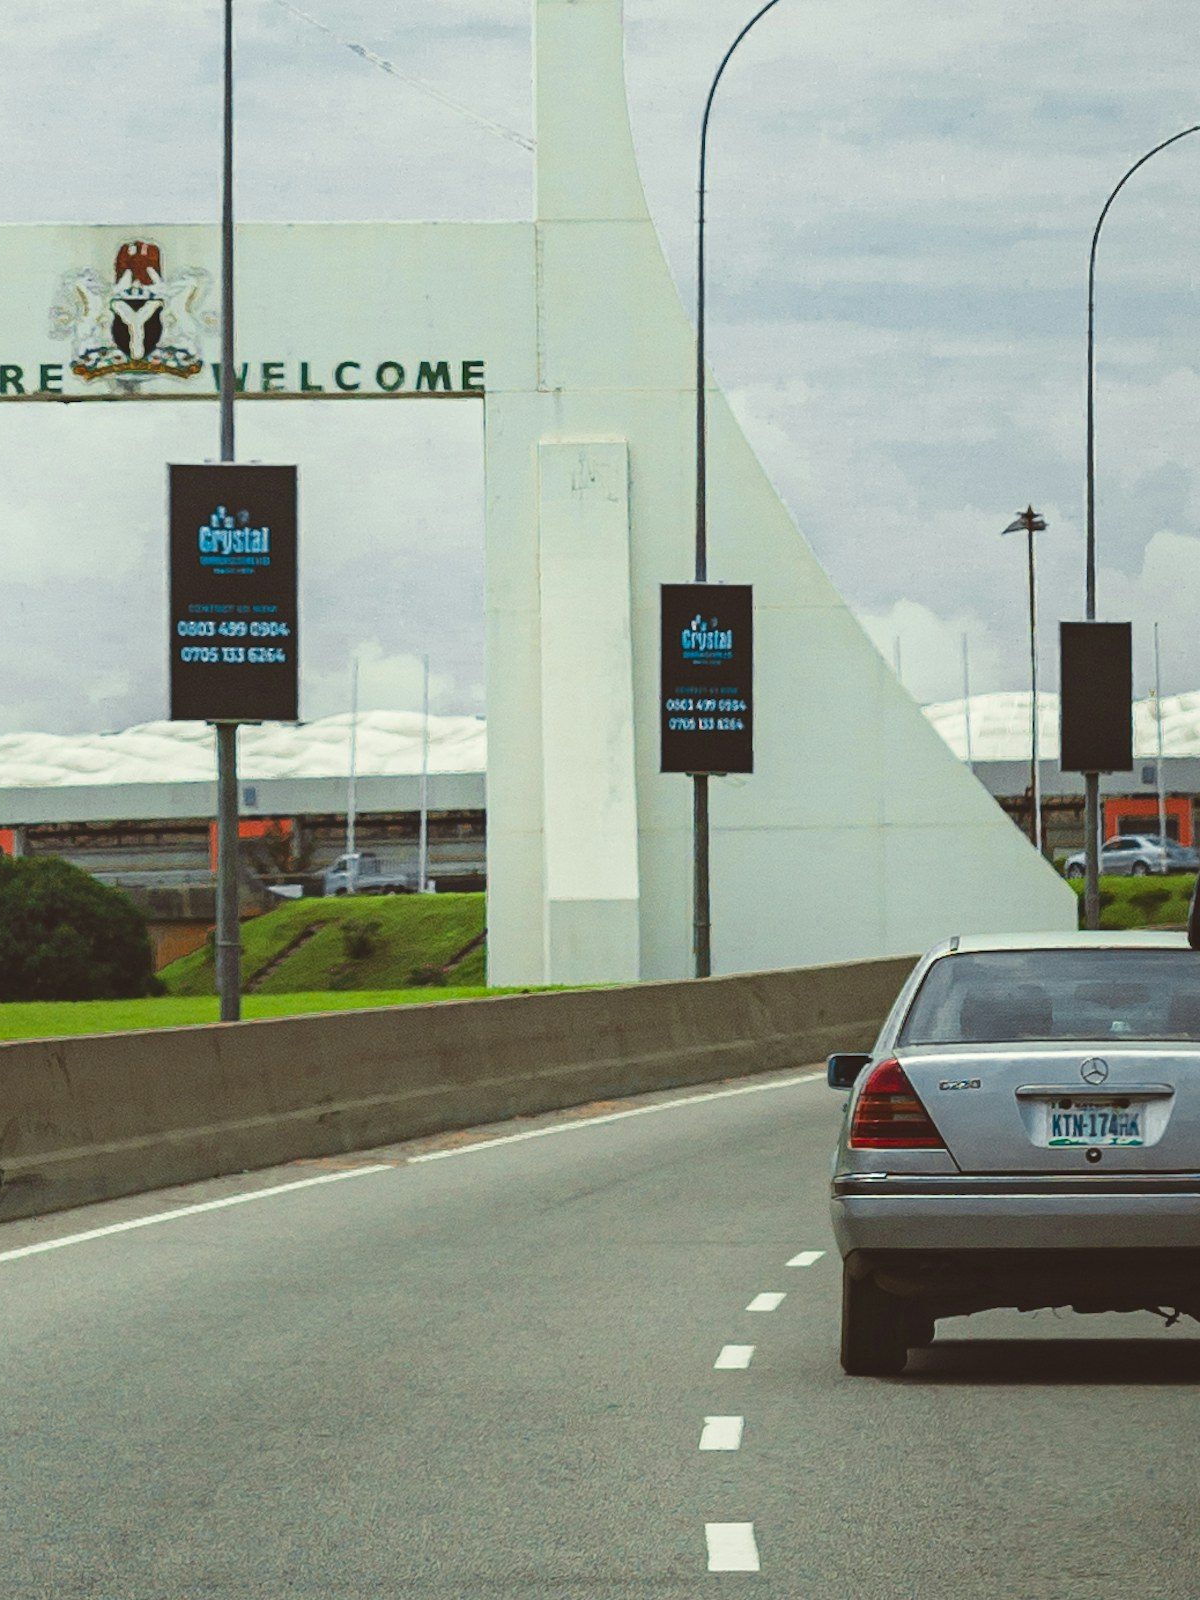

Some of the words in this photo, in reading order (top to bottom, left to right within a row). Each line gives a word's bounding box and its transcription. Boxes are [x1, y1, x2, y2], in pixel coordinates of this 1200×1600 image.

[211, 360, 485, 393] WELCOME
[198, 526, 271, 556] Crystal
[681, 629, 733, 651] Crystal
